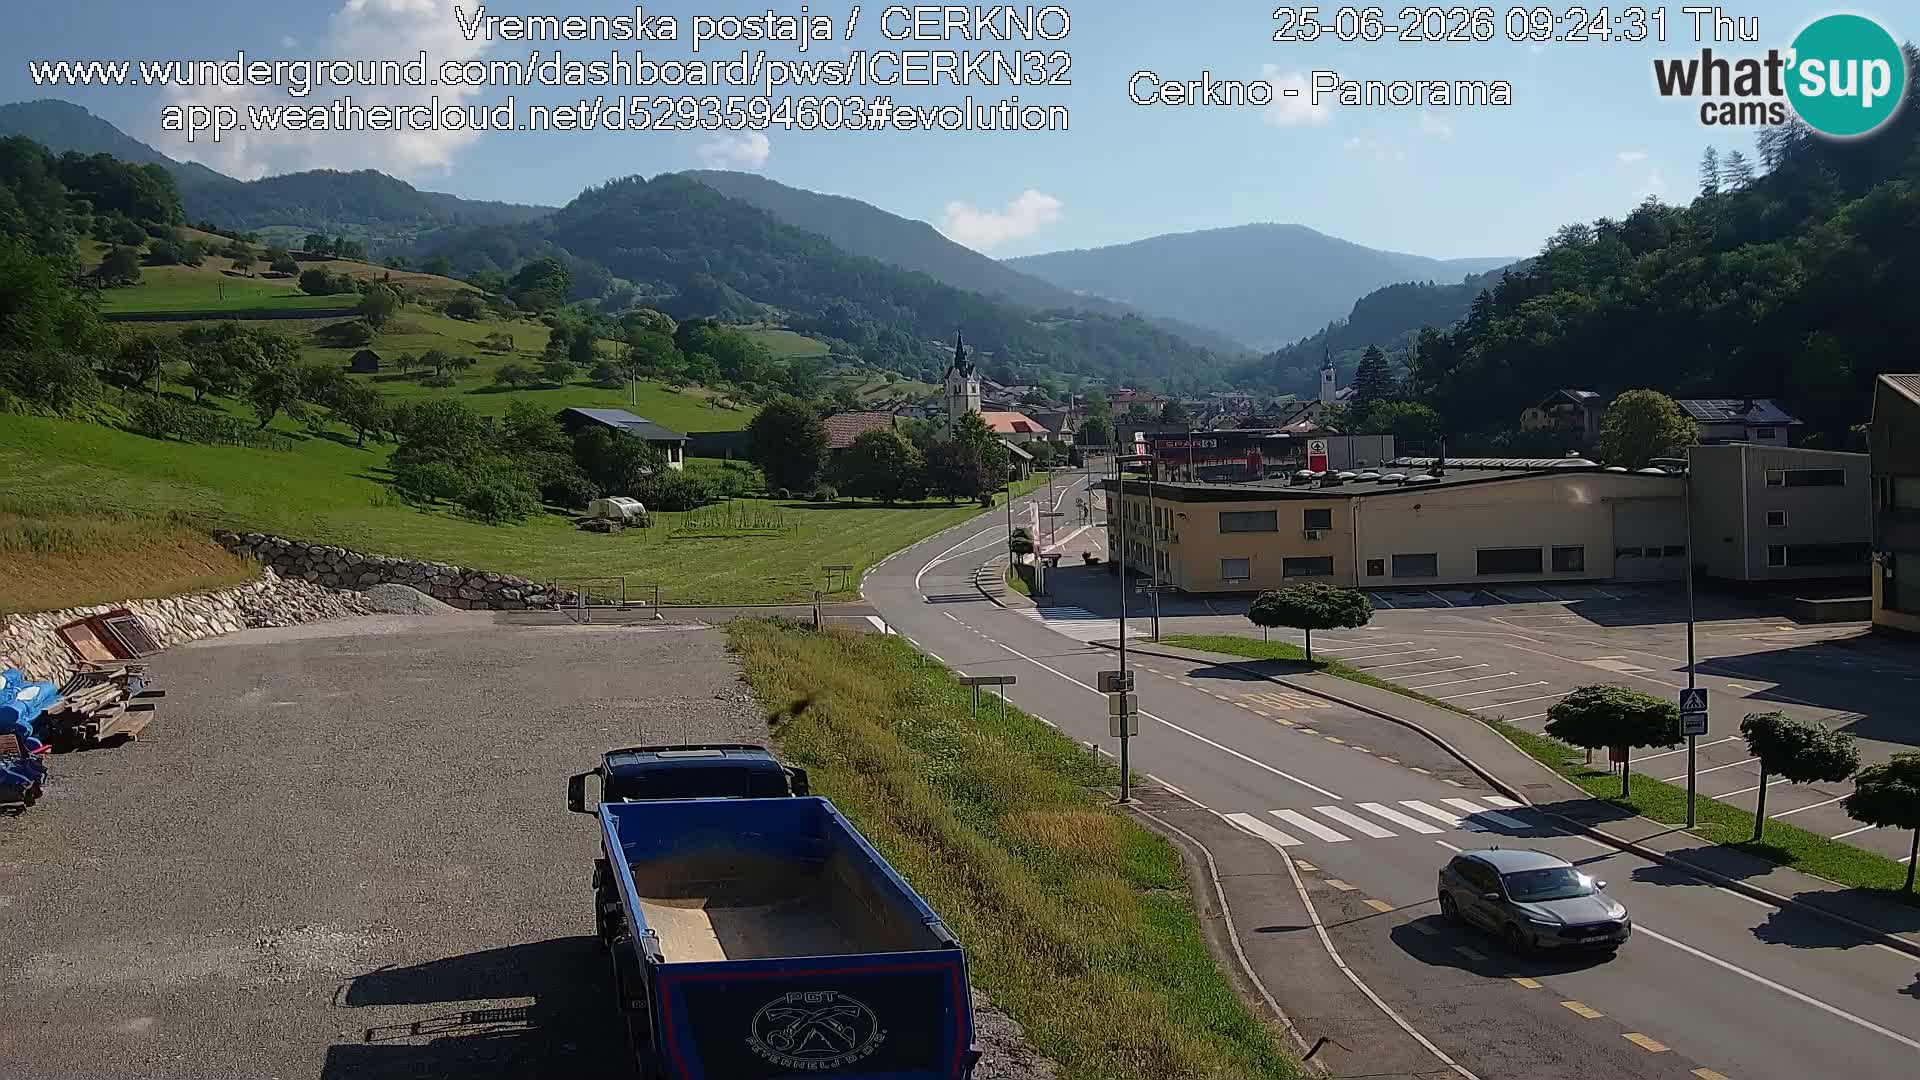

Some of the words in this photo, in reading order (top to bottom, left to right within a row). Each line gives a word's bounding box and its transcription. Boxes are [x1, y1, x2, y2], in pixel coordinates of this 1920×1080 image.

[1165, 440, 1202, 449] SPAR
[785, 990, 838, 1004] PGT
[744, 1037, 840, 1069] PETERNELJ
